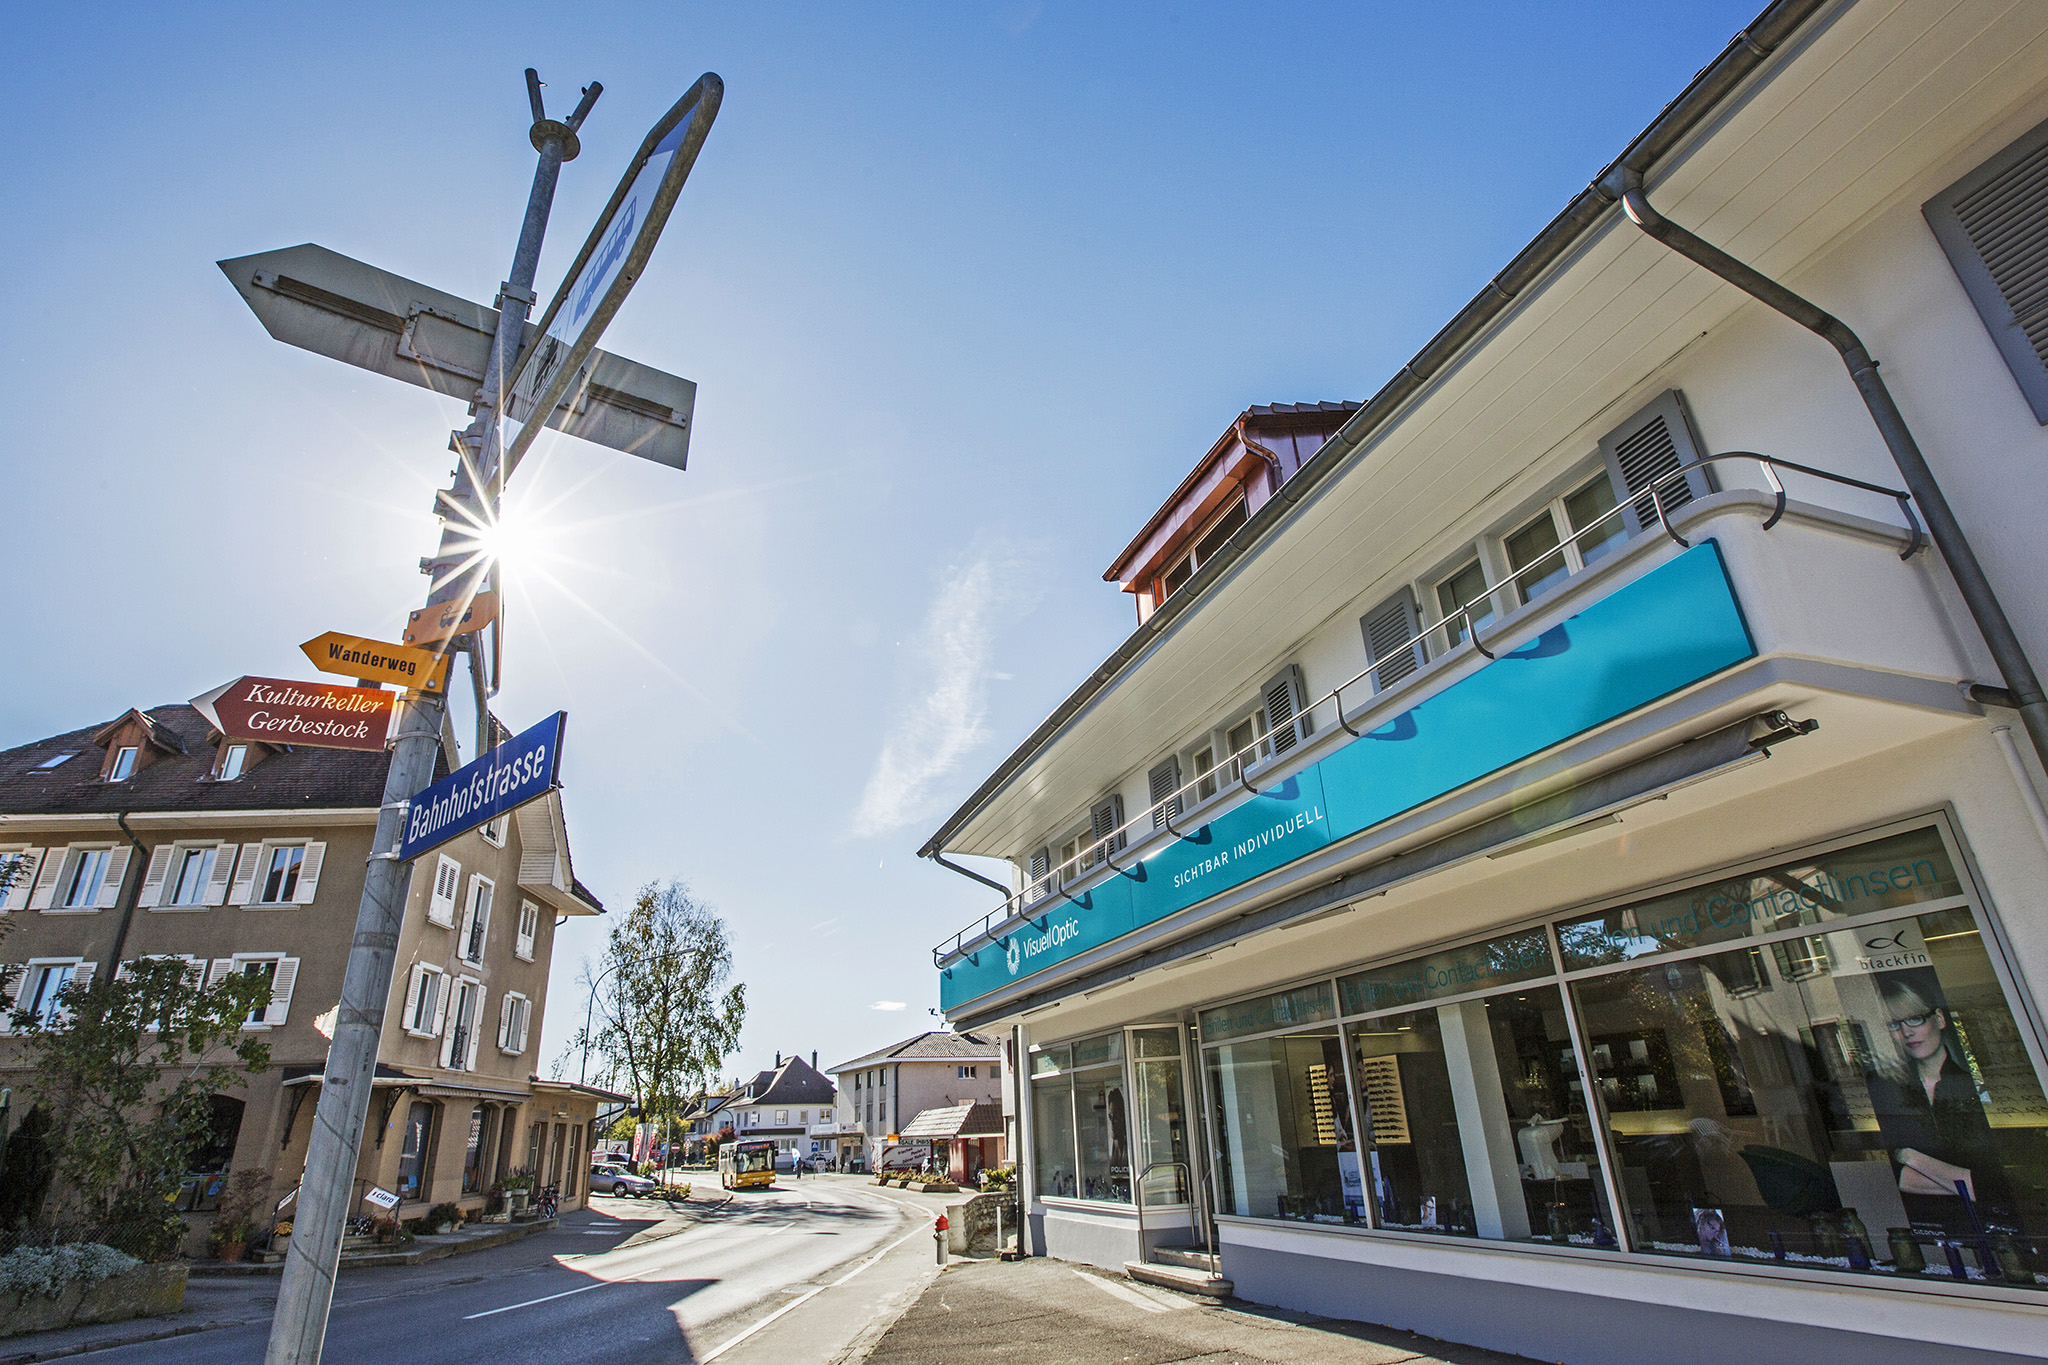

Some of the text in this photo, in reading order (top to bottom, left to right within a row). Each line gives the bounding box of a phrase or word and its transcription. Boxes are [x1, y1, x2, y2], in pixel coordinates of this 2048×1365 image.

[328, 642, 417, 677] Wanderweg
[243, 683, 385, 715] Kulturkeller
[247, 710, 371, 740] Gerbestock
[408, 744, 545, 845] Bahnhofstrasse
[1173, 806, 1324, 888] SICHTBAR INDIVIDUELL
[1568, 858, 1939, 958] Brillen und Contactlinsen
[1344, 948, 1546, 1007] Brillen und Contactlinsen
[1859, 951, 1928, 971] blackfin
[377, 1193, 394, 1203] claro
